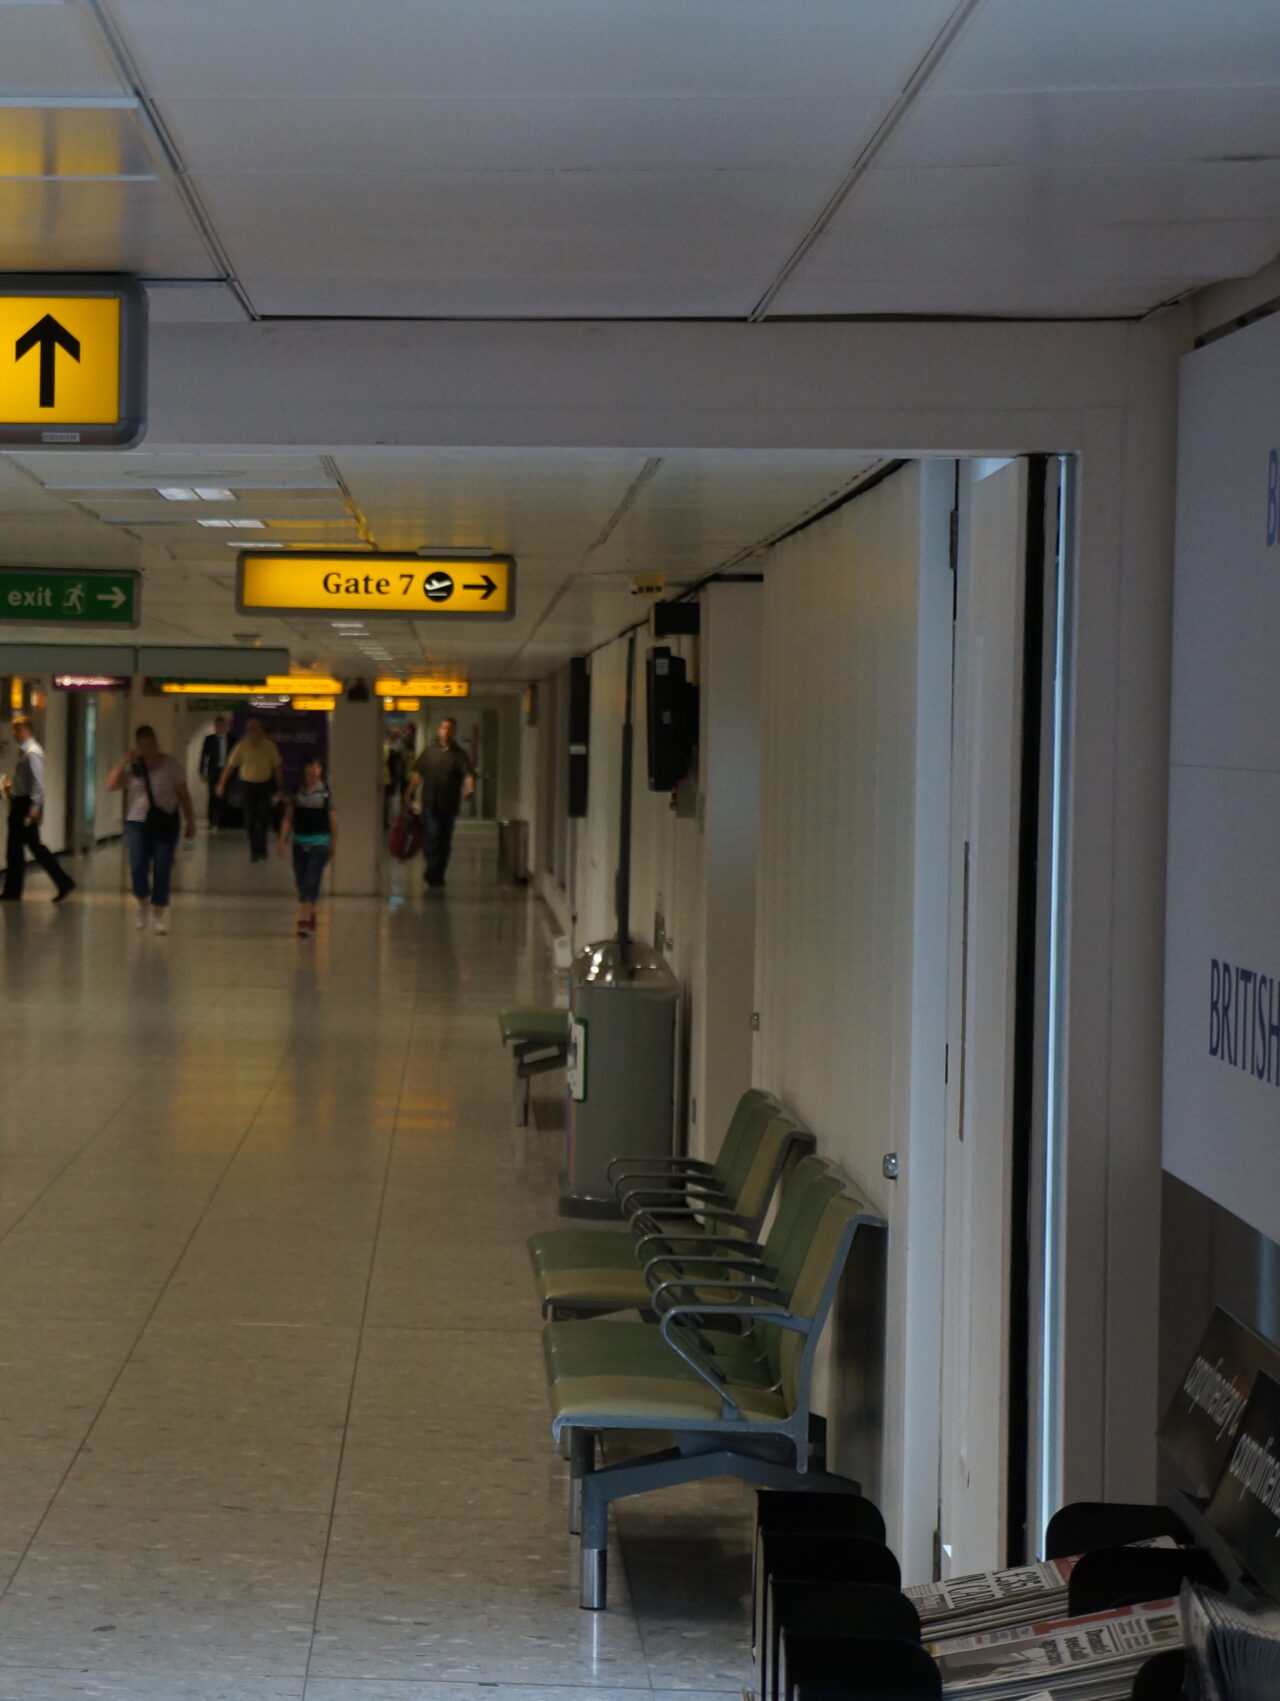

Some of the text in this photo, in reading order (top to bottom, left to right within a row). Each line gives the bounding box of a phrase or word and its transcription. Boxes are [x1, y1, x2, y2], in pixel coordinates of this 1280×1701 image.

[7, 583, 53, 607] exit
[322, 571, 415, 597] Gate 7
[1209, 958, 1280, 1087] BRITISH
